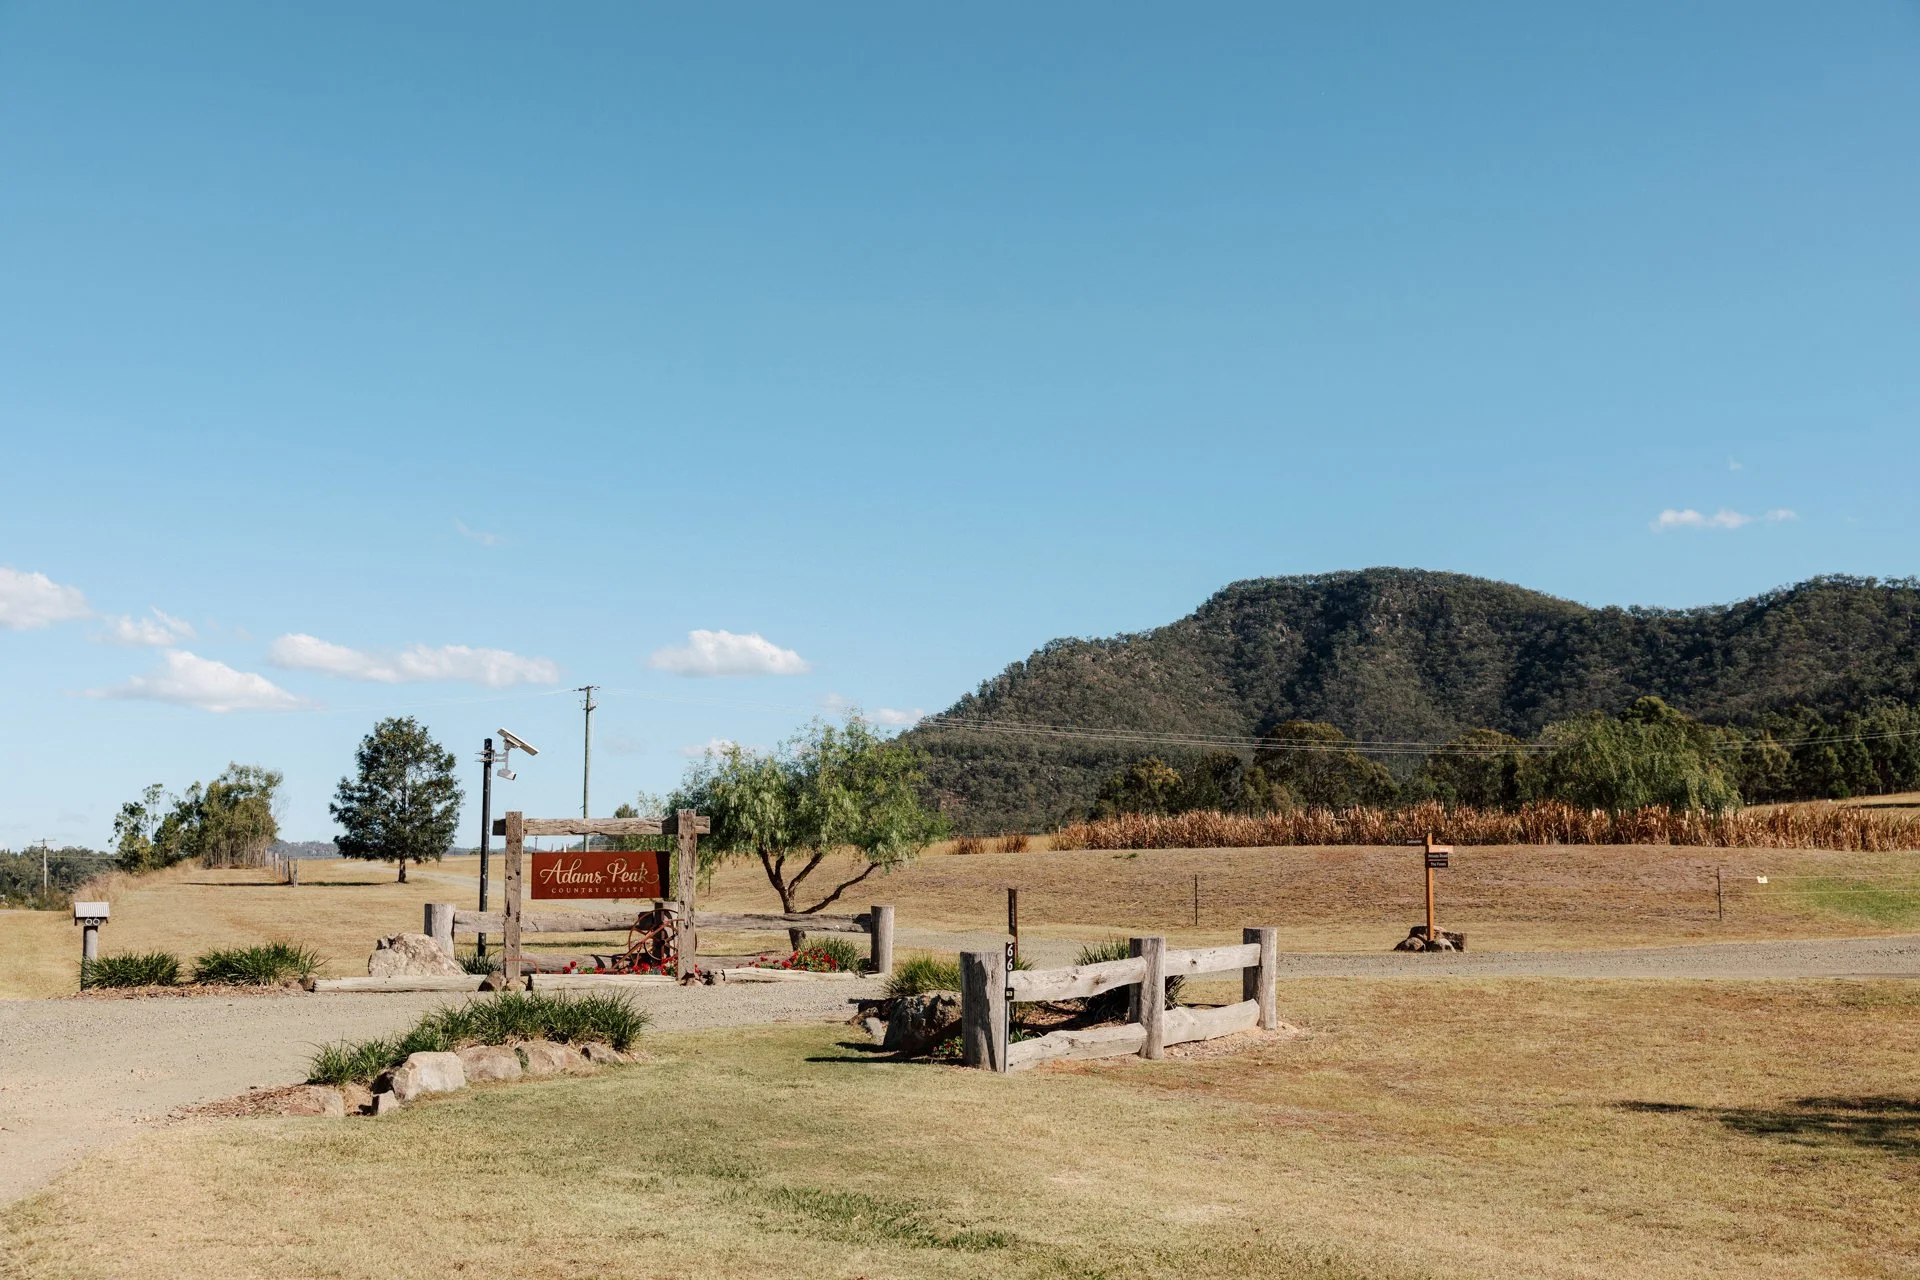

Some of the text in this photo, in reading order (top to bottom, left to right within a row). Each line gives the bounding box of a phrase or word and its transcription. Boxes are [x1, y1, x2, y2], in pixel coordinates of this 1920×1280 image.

[540, 858, 659, 884] Adams Peak
[1007, 944, 1014, 971] 66
